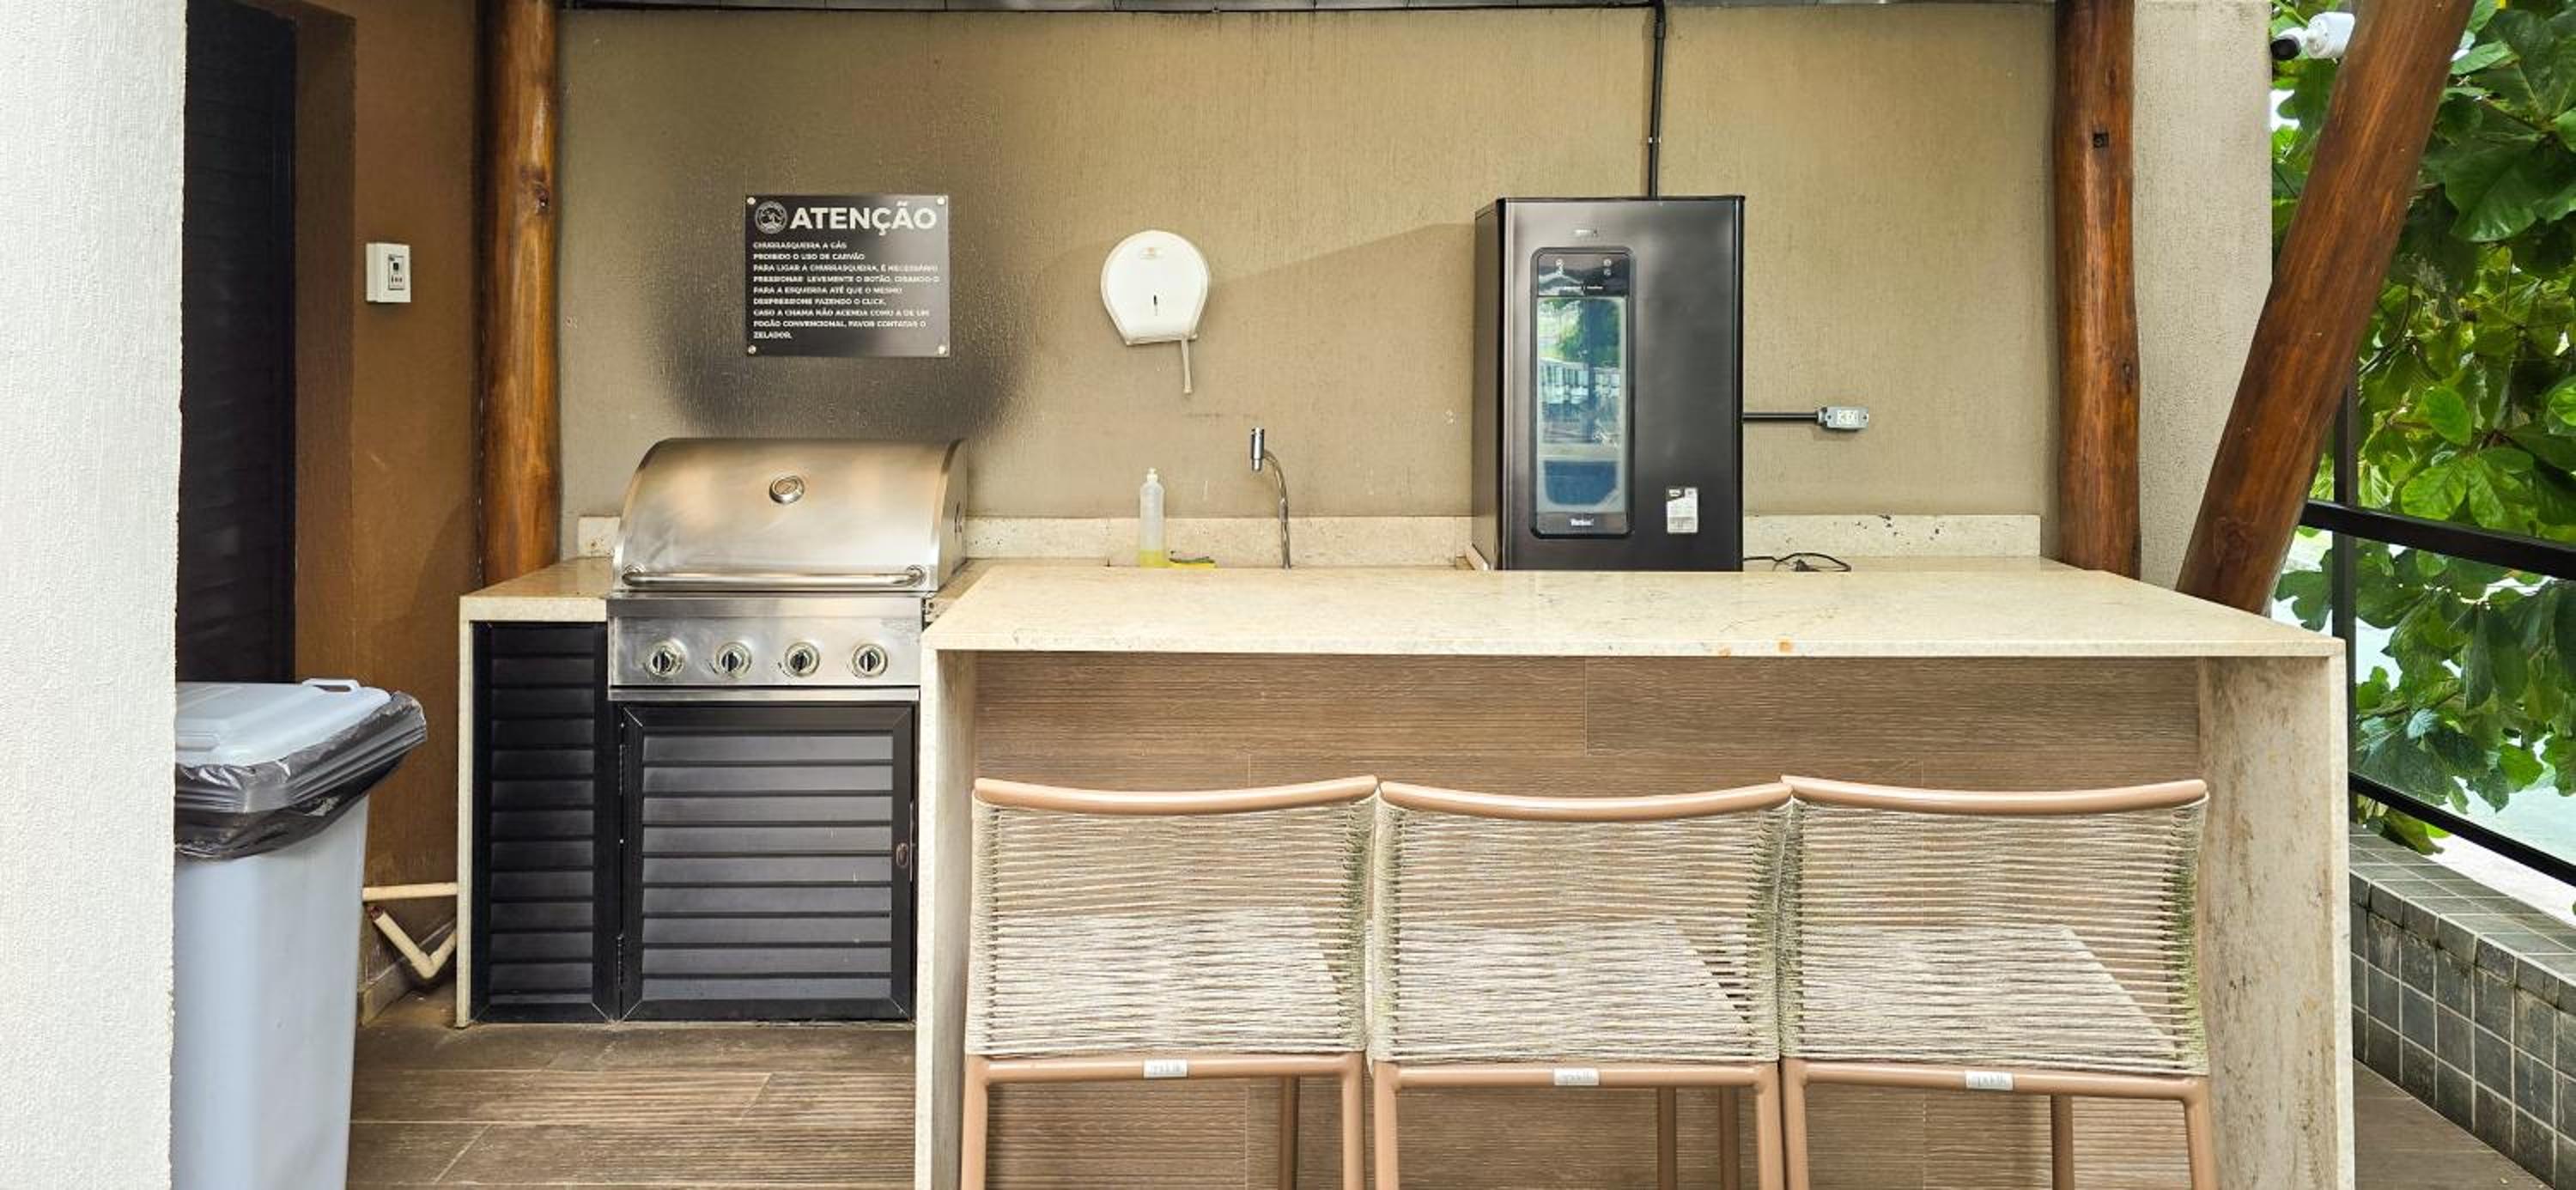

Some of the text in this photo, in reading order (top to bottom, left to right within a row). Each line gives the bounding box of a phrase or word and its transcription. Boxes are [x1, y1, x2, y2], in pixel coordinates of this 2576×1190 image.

[789, 201, 937, 235] ATENÇÃO
[753, 241, 821, 250] CHURRASQUEIRA
[830, 240, 847, 249] GÁS
[829, 285, 844, 294] ATÉ
[815, 307, 834, 316] NÃO
[753, 319, 781, 327] FOGÃO
